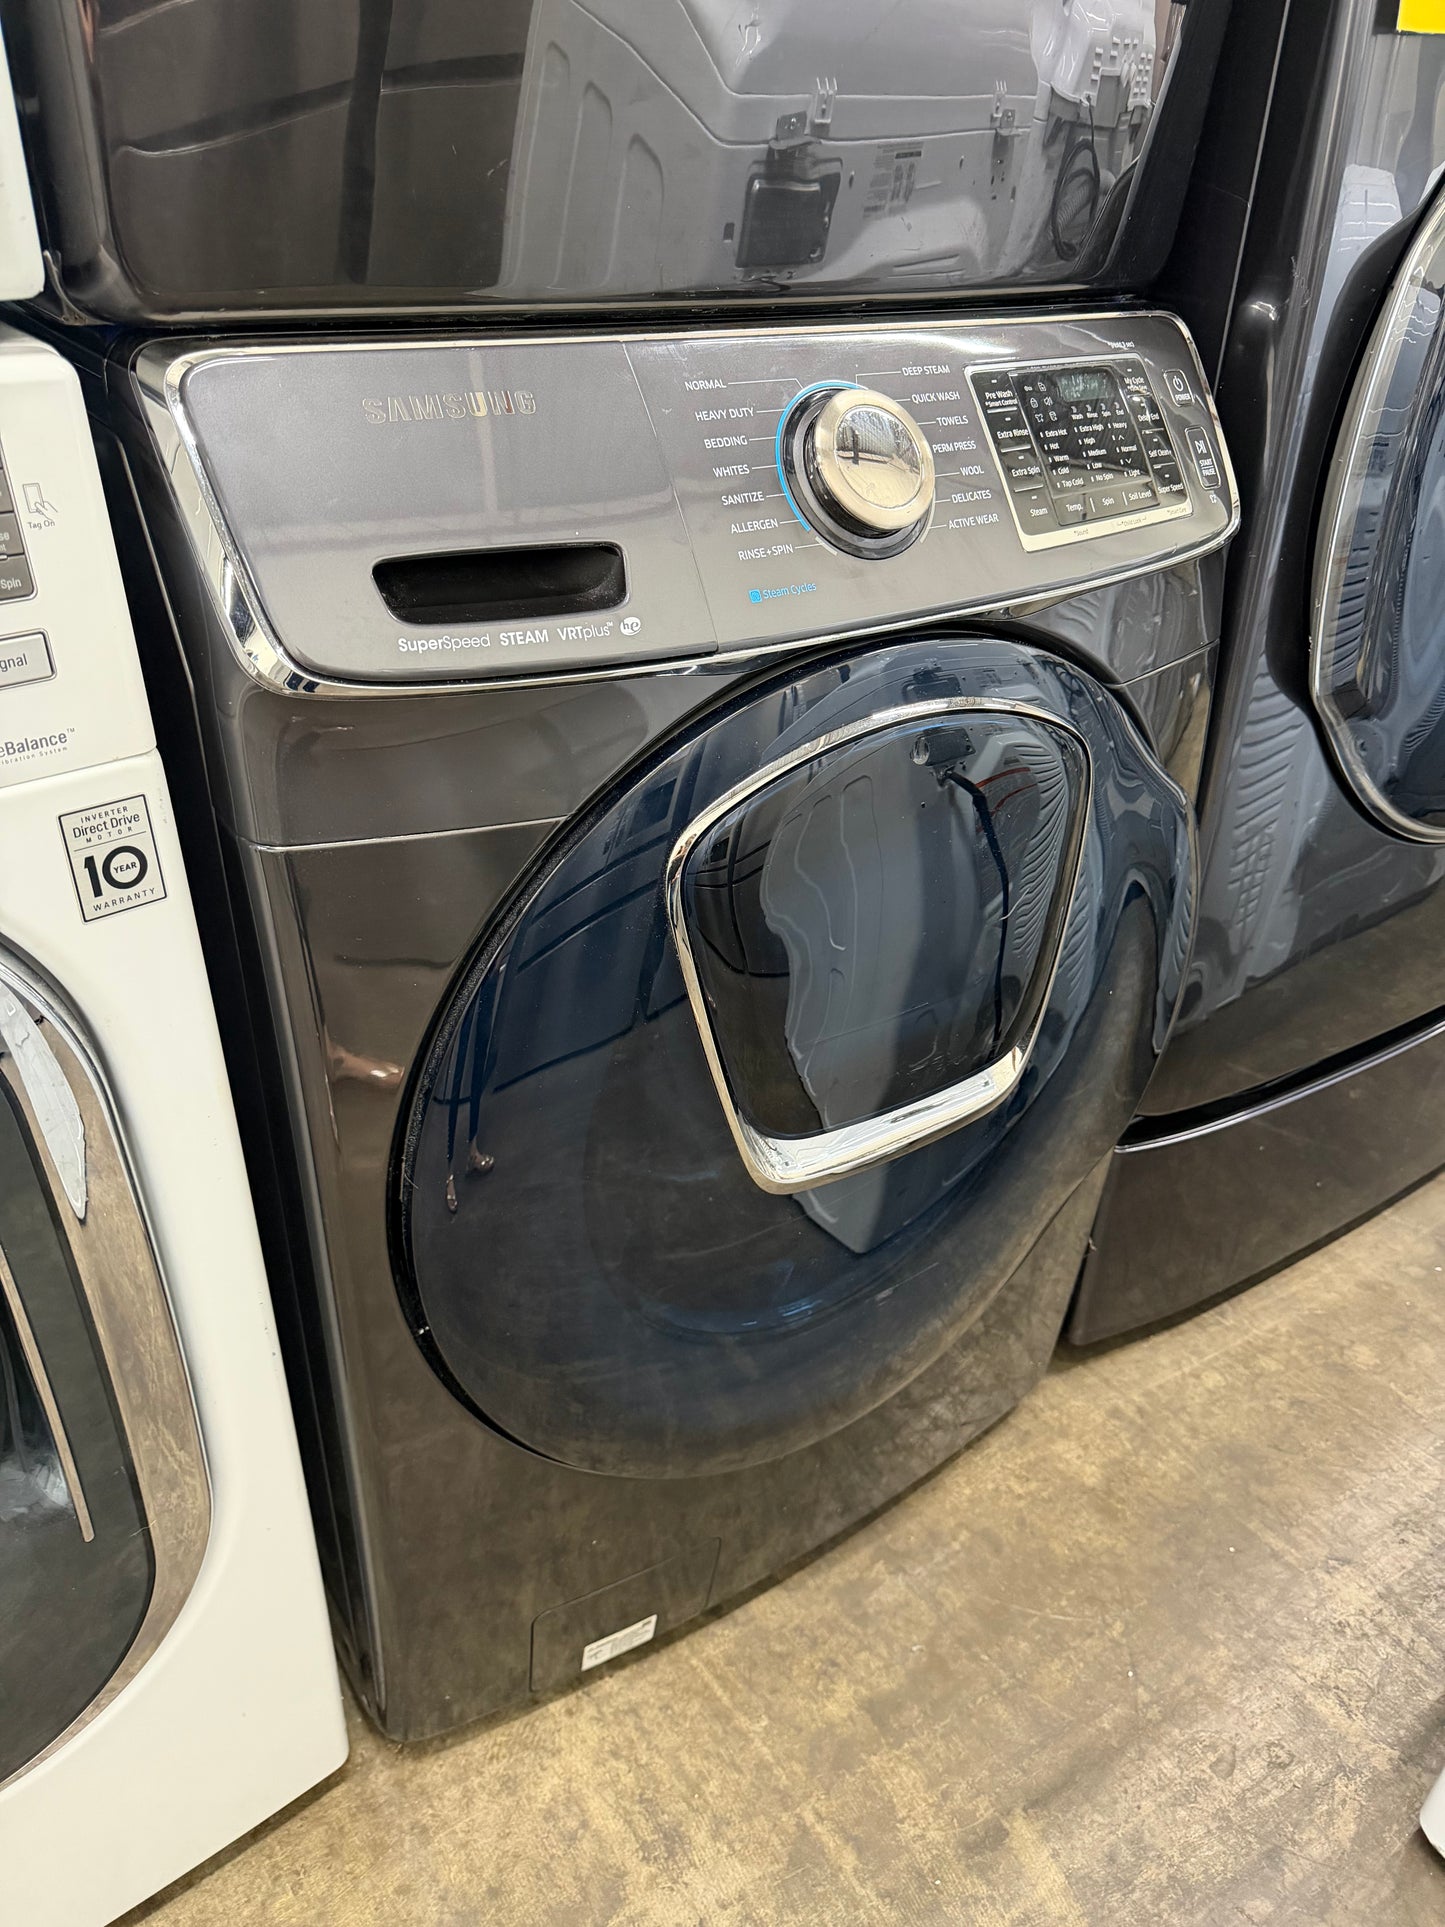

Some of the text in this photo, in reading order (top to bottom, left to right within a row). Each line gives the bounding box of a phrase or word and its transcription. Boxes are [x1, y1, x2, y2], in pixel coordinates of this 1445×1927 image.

[902, 365, 950, 376] DEEP STEAM
[685, 379, 727, 391] NORMAL
[911, 391, 960, 404] QUICK WASH
[985, 389, 1013, 400] Pre Wash
[1175, 393, 1191, 401] POWER
[362, 391, 536, 424] SAMSUNG
[695, 407, 754, 421] HEAVY DUTY
[936, 415, 969, 426] TOWELS
[997, 428, 1029, 439] Extra Rinse
[1045, 428, 1068, 438] Extra Hot
[1079, 423, 1104, 433] Extra High
[704, 435, 748, 449] BEDDING
[932, 440, 977, 453] PERM PRESS
[1049, 442, 1060, 450] Hot
[1083, 437, 1096, 445] High
[1087, 449, 1107, 457] Medium
[1120, 445, 1137, 453] Normal
[1148, 450, 1158, 458] Self
[1091, 462, 1103, 470] Low
[1199, 458, 1213, 467] START
[713, 464, 750, 478] WHITES
[960, 465, 985, 476] WOOL
[1011, 466, 1041, 477] Extra Spin
[1057, 467, 1070, 475] Cold
[1128, 469, 1140, 478] Light
[1202, 469, 1216, 477] PAUSE
[1103, 472, 1114, 481] Spin
[1061, 478, 1084, 488] Tap Cold
[1158, 483, 1184, 494] Super Speed
[721, 491, 765, 506] SANITIZE
[951, 489, 992, 503] DELICATES
[1128, 489, 1152, 501] Soil Level
[1102, 497, 1115, 506] Spin
[1030, 507, 1048, 517] Steam
[1066, 503, 1084, 513] Temp.
[27, 521, 42, 530] Tag
[731, 518, 779, 534] ALLERGEN
[948, 513, 999, 530] ACTIVE WEAR
[0, 577, 22, 591] Spin
[762, 582, 817, 600] Steam Cycles
[398, 634, 491, 654] SuperSpeed
[500, 629, 549, 646] STEAM
[39, 746, 68, 758] System
[80, 805, 129, 824] INVERTER
[72, 813, 140, 838] Direct Drive
[86, 826, 133, 844] MOTOR
[84, 845, 148, 898] 10
[113, 861, 138, 874] YEAR
[92, 887, 156, 912] WARRANTY
